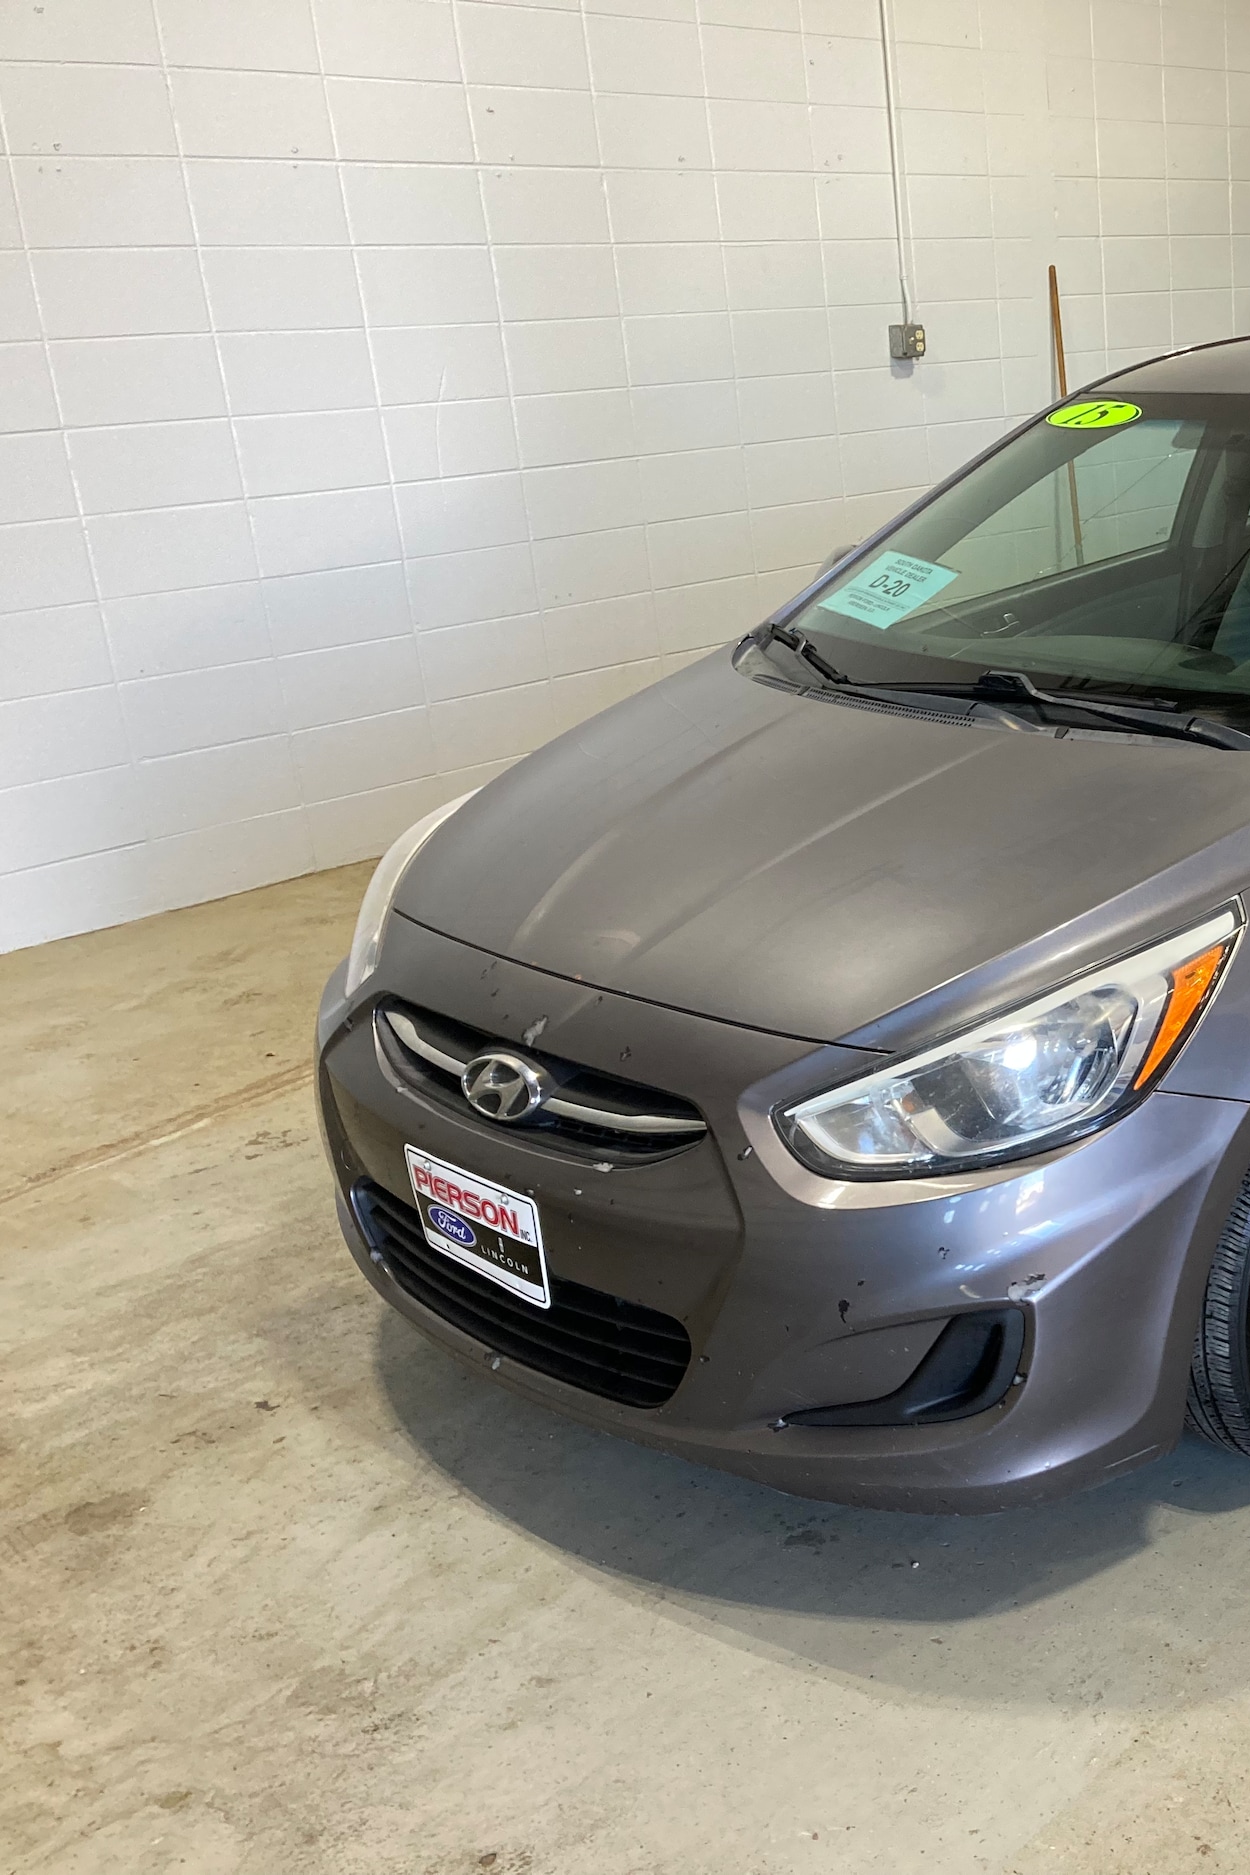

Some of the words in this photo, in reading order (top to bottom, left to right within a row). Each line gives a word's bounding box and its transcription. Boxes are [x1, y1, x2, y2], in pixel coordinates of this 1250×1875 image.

[1057, 404, 1128, 425] 15
[904, 572, 928, 583] DEALER
[911, 564, 934, 575] DAKOTA
[868, 574, 911, 597] D-20
[413, 1163, 521, 1238] PIERSON
[437, 1210, 467, 1241] Ford
[481, 1245, 529, 1275] LINCOLN
